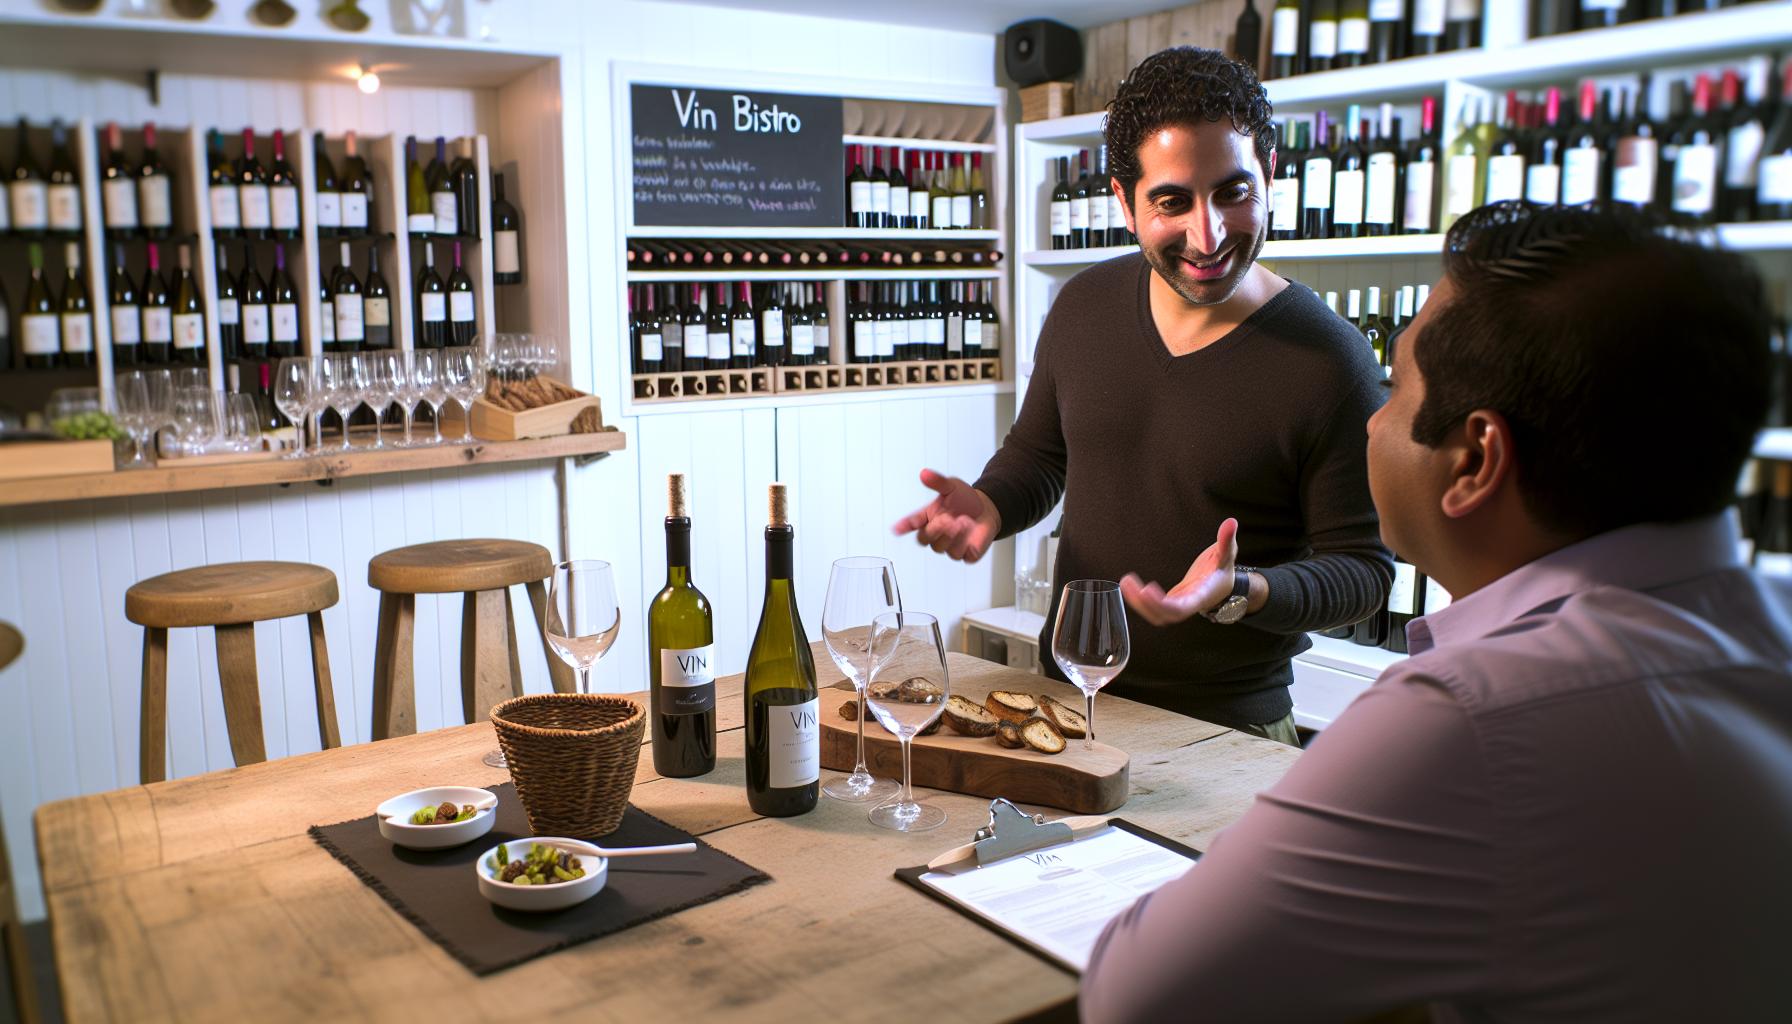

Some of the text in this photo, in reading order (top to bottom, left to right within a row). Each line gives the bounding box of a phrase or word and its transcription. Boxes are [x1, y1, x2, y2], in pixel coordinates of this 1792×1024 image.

[671, 89, 801, 133] Vin Bistro
[677, 655, 707, 674] VIN
[790, 711, 816, 729] VIN
